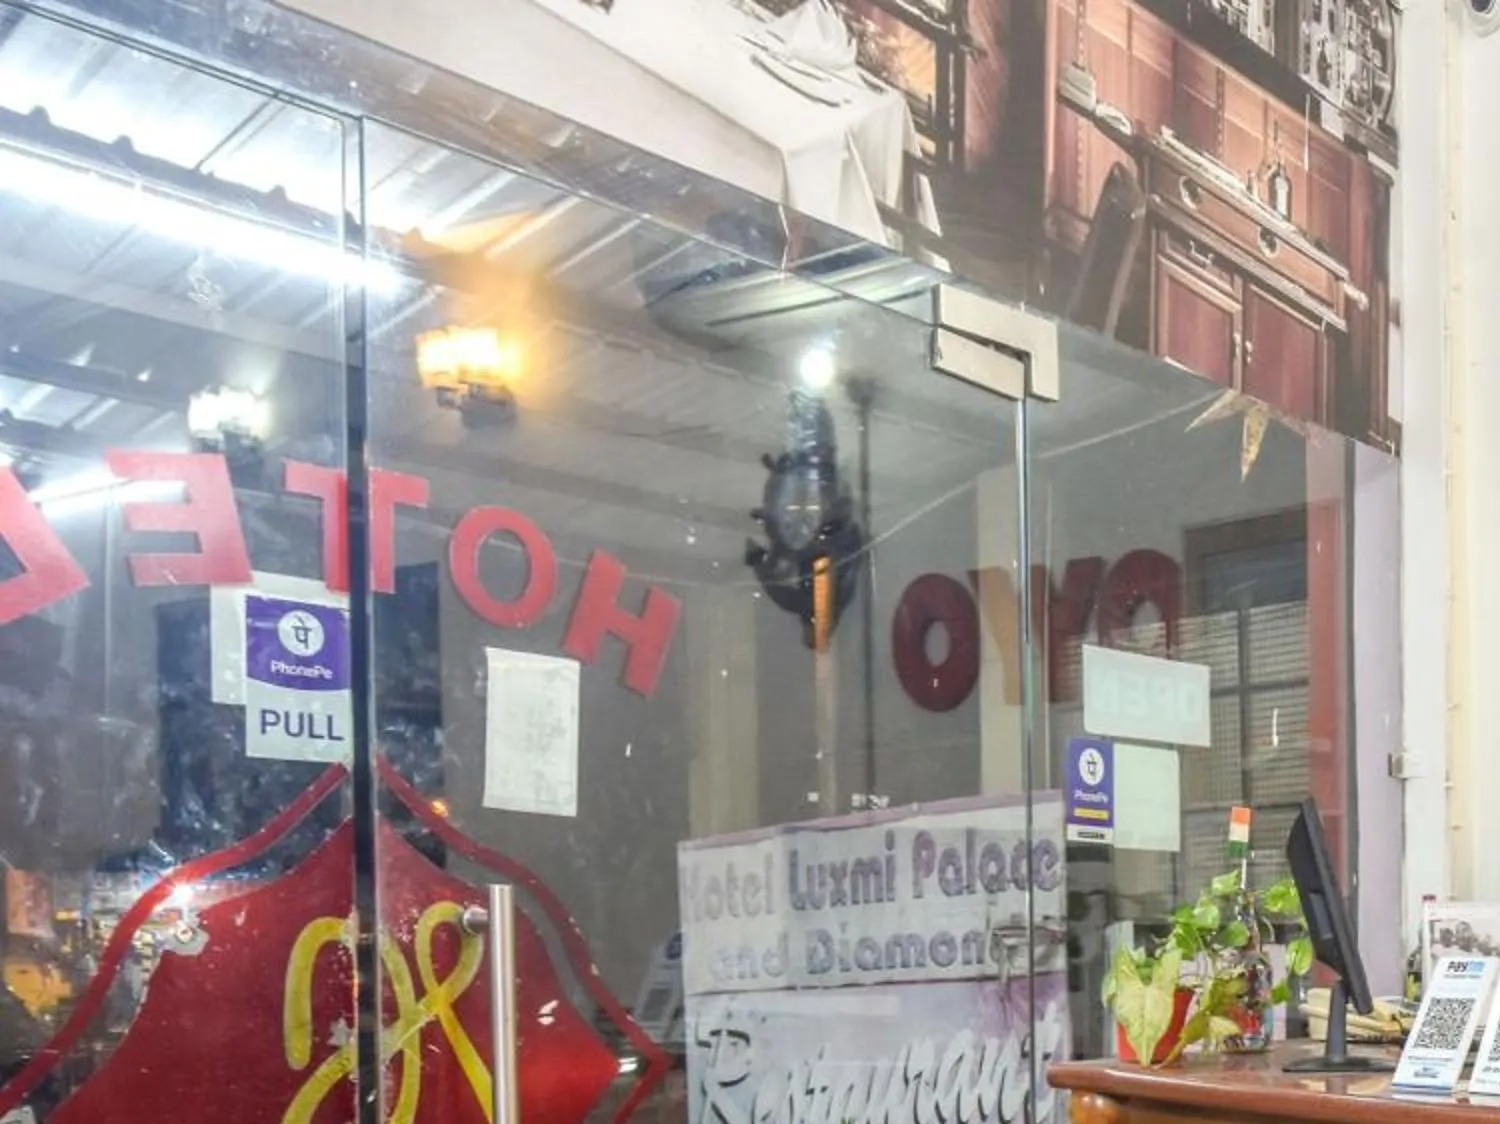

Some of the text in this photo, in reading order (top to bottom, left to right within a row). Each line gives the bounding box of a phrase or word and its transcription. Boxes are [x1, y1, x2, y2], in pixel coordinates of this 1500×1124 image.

[271, 658, 333, 680] PhonePe
[260, 709, 344, 741] PULL
[788, 830, 896, 911] Luxmi
[912, 828, 1060, 900] Palace
[711, 932, 790, 981] and
